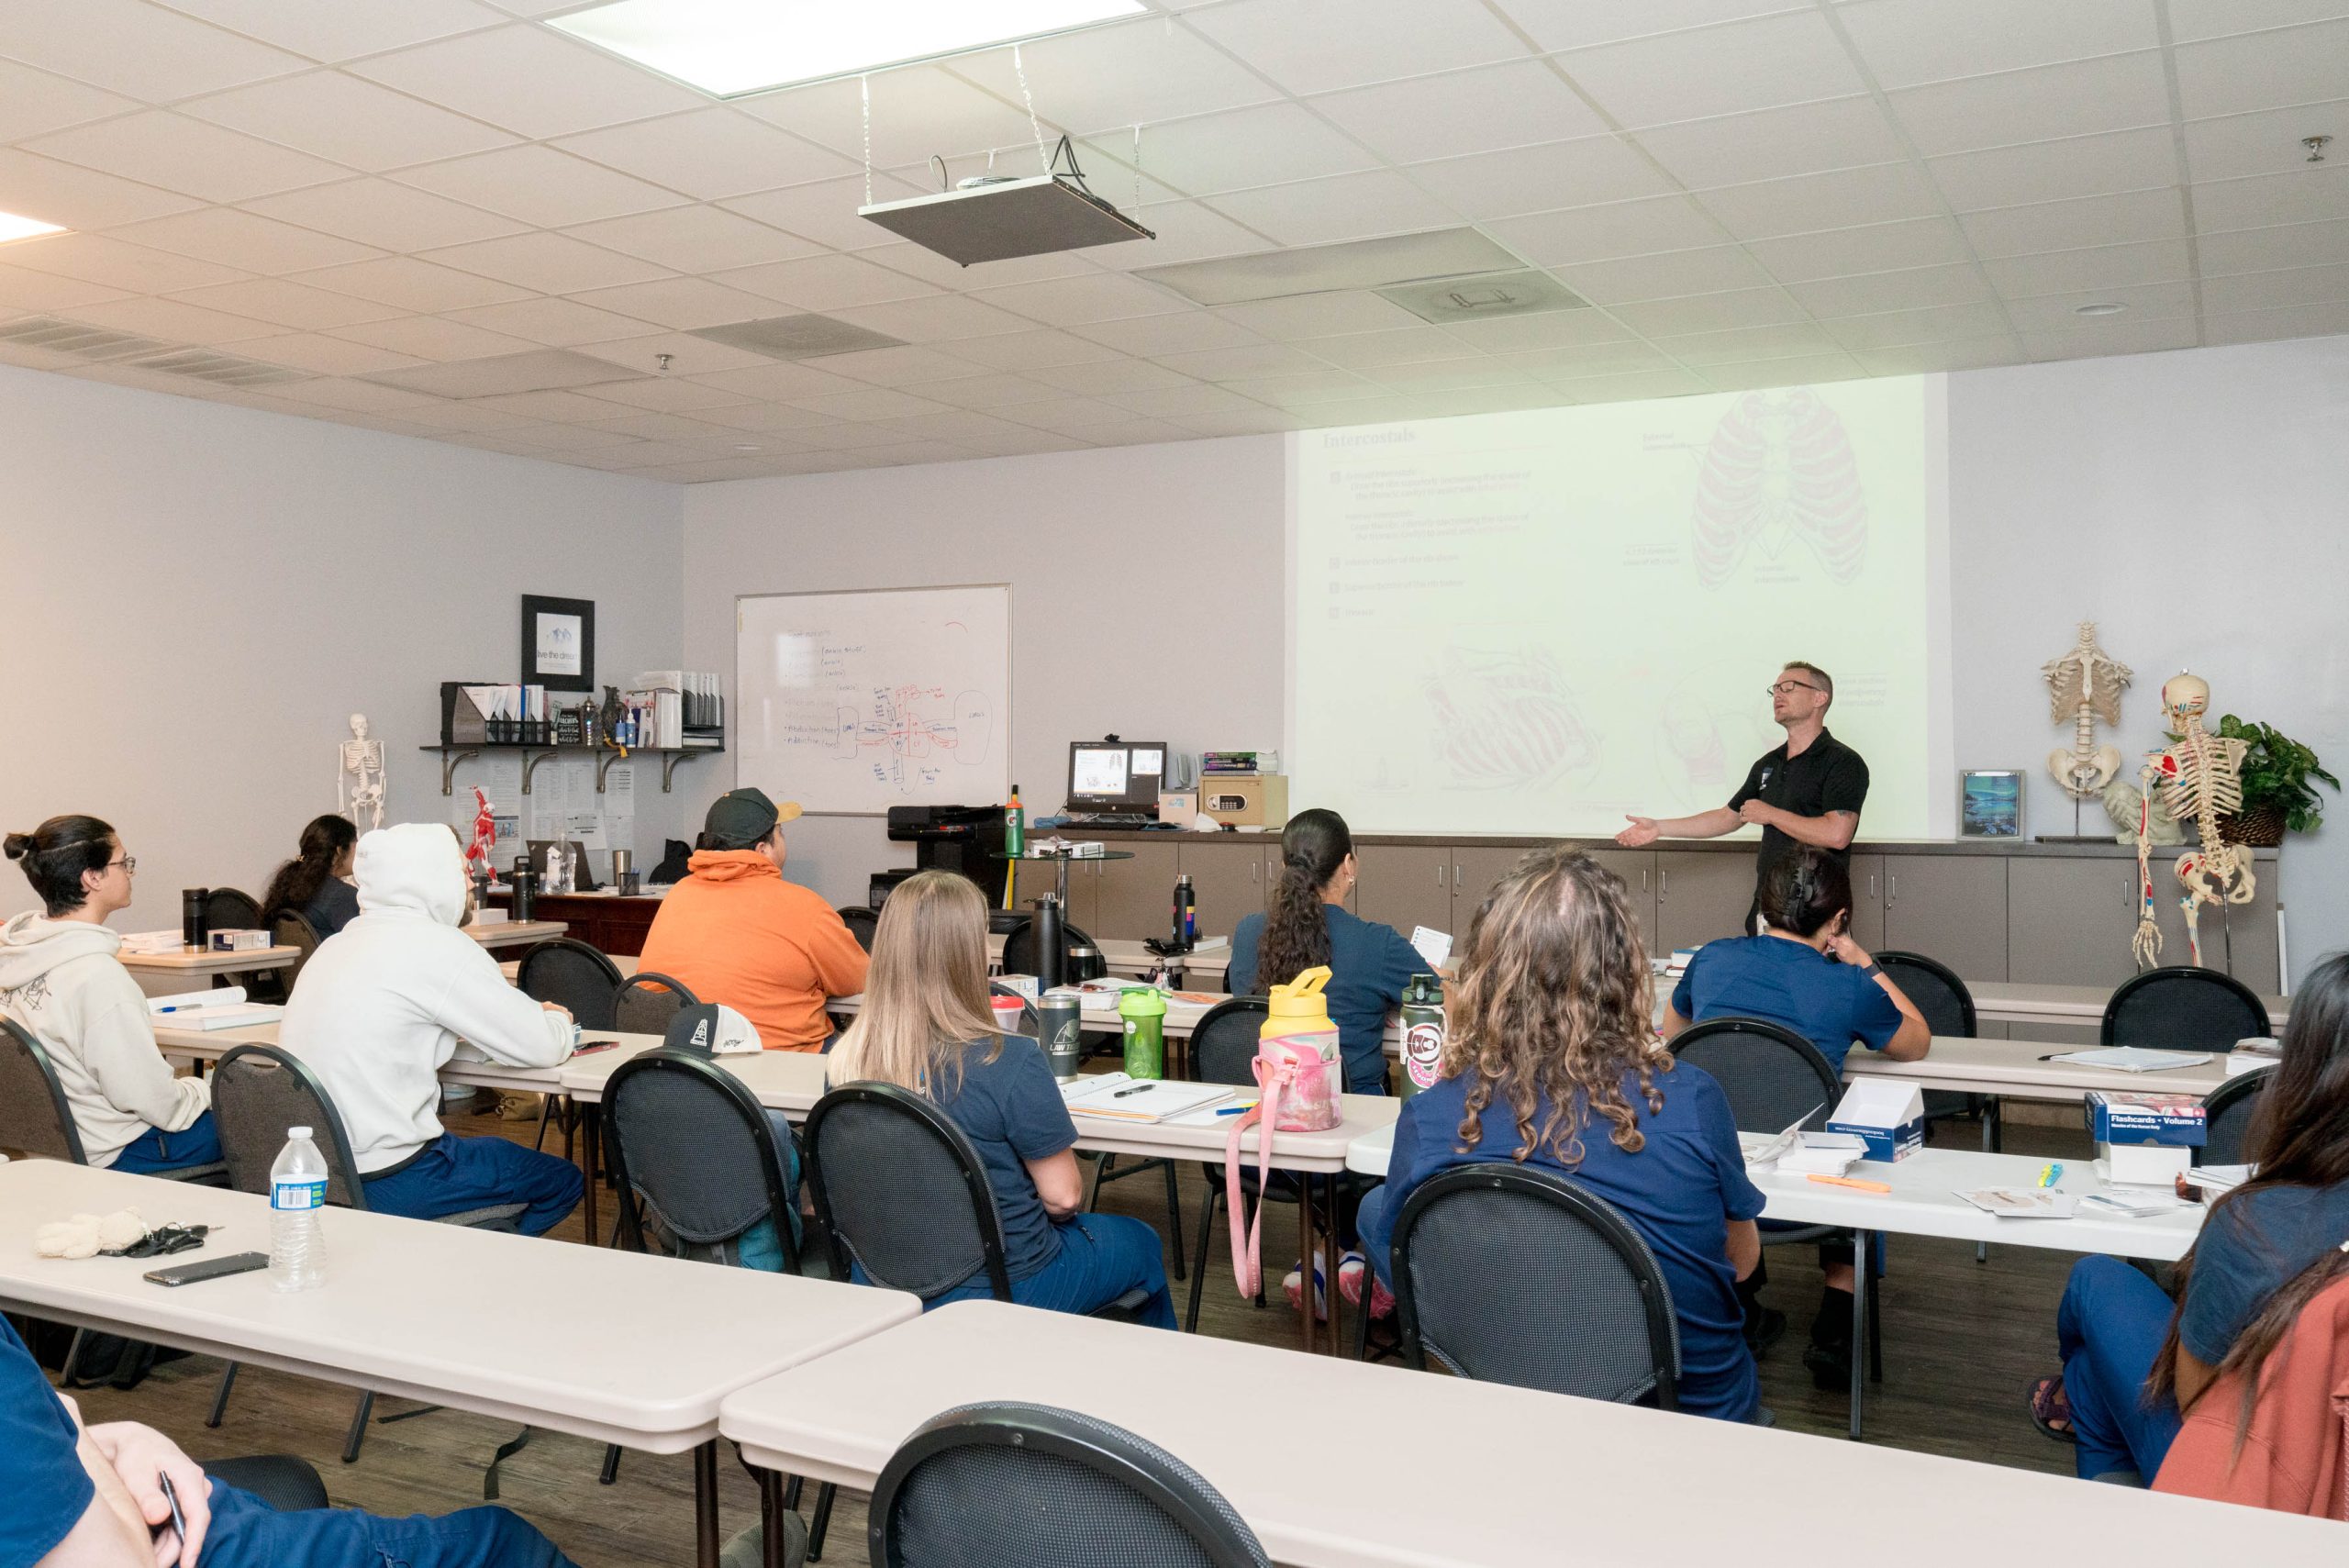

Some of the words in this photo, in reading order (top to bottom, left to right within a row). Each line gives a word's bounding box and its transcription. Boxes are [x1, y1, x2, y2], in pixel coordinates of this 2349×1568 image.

[1323, 428, 1417, 449] Intercostals
[549, 651, 560, 659] the
[1050, 1043, 1066, 1051] LAW
[2111, 1115, 2155, 1124] Flashcards
[2163, 1117, 2196, 1126] Volume
